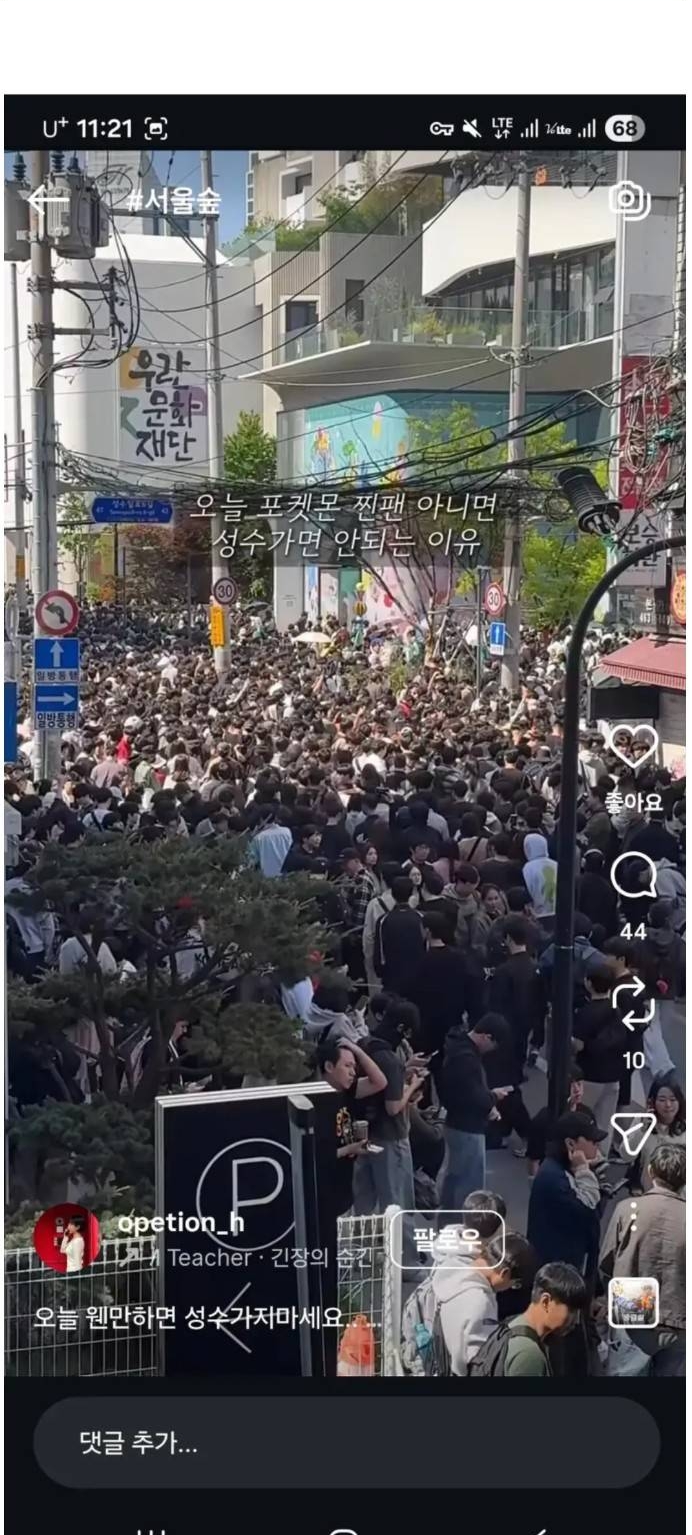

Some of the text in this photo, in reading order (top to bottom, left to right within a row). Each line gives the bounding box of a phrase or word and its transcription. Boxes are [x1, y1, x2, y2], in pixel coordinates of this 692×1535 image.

[129, 350, 192, 392] 우란
[143, 390, 200, 428] 문화
[136, 429, 197, 461] 재단
[218, 584, 232, 598] 30
[487, 591, 499, 604] 30
[37, 713, 76, 728] 일방통행
